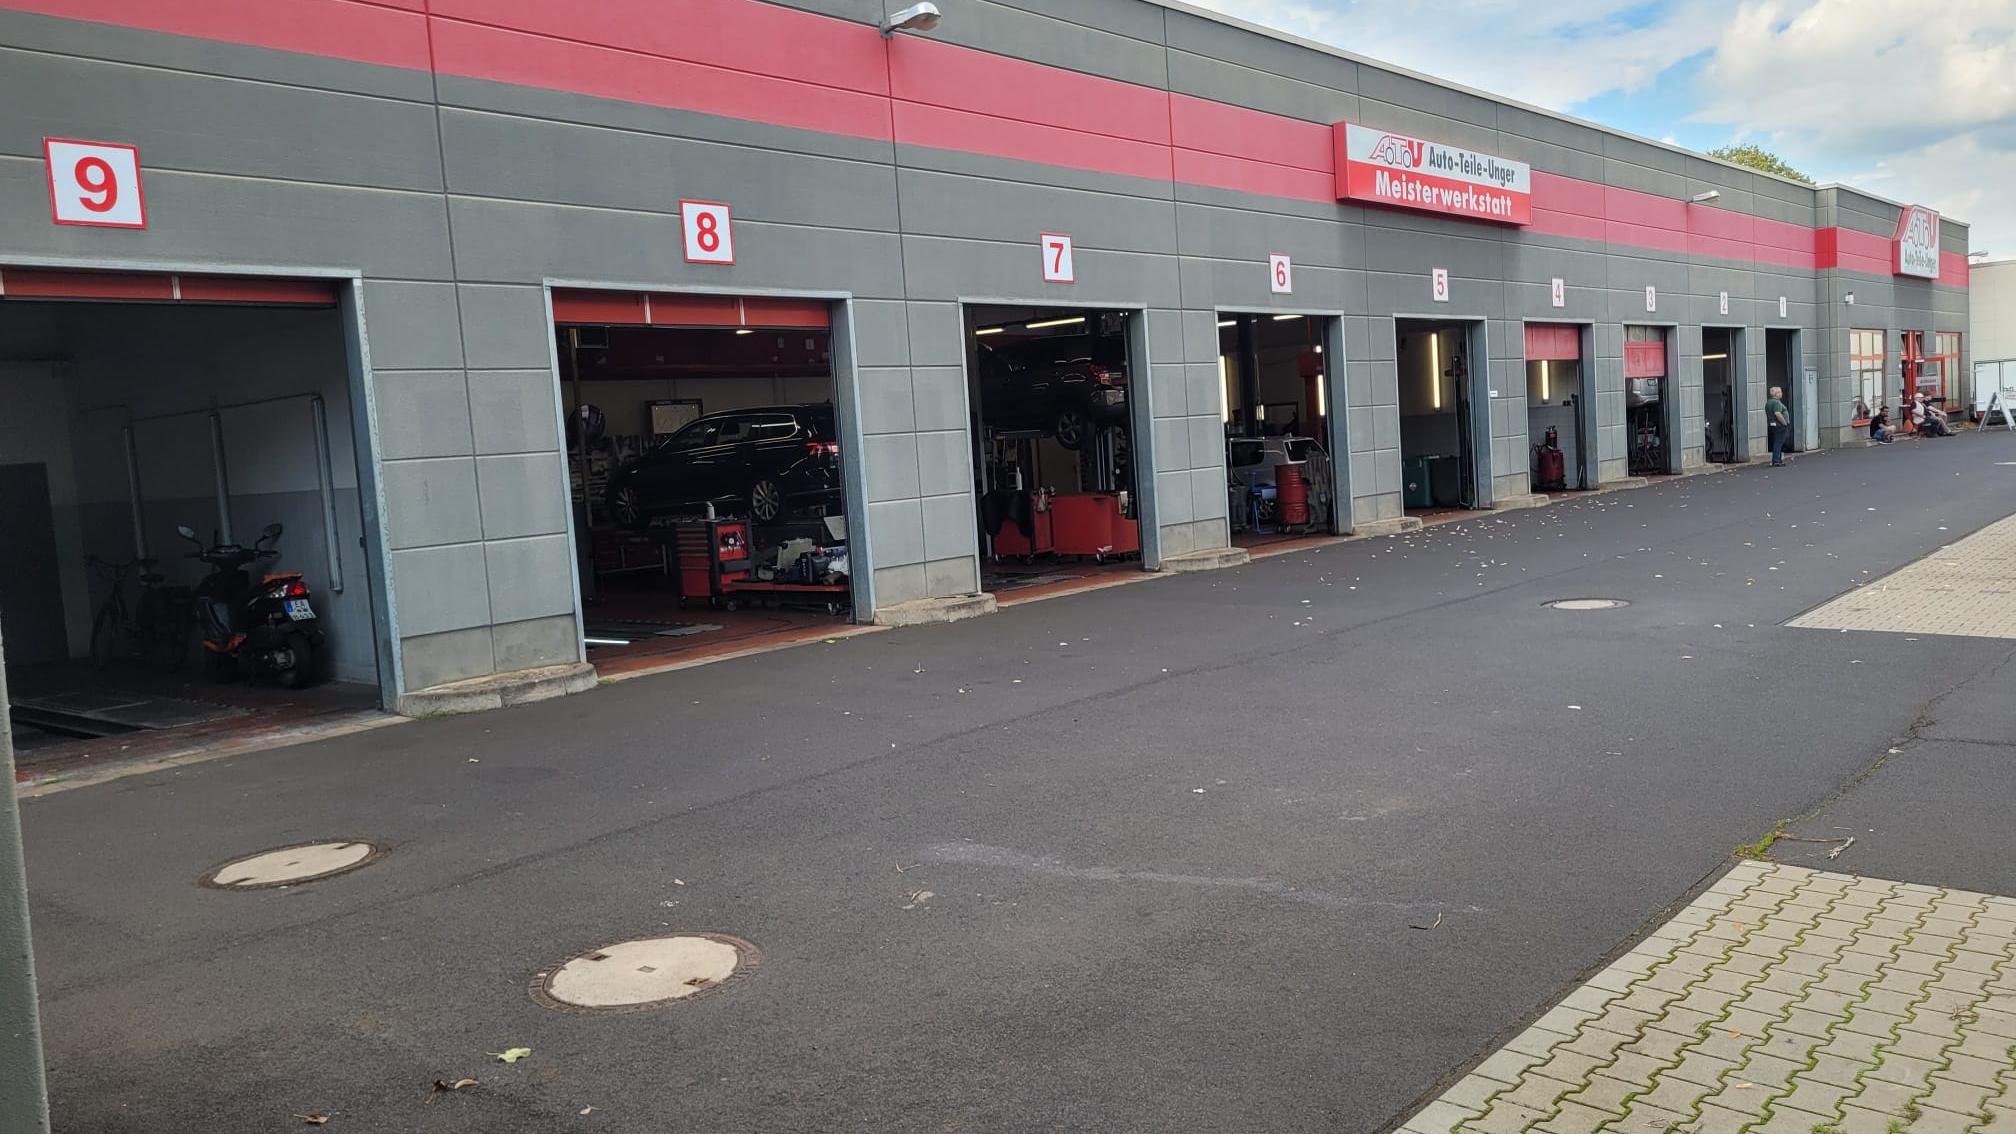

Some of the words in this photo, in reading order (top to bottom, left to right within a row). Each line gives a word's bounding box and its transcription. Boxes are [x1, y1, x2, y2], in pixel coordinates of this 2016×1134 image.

[1428, 146, 1515, 187] Auto-Teile-Unger
[74, 157, 117, 212] 9
[1375, 170, 1511, 216] Meisterwerkstatt
[696, 212, 720, 252] 8
[1049, 242, 1064, 273] 7
[1276, 261, 1286, 287] 6
[1437, 274, 1445, 296] 5
[1555, 282, 1561, 302] 4
[1648, 291, 1653, 308] 3
[1721, 295, 1727, 311] 2
